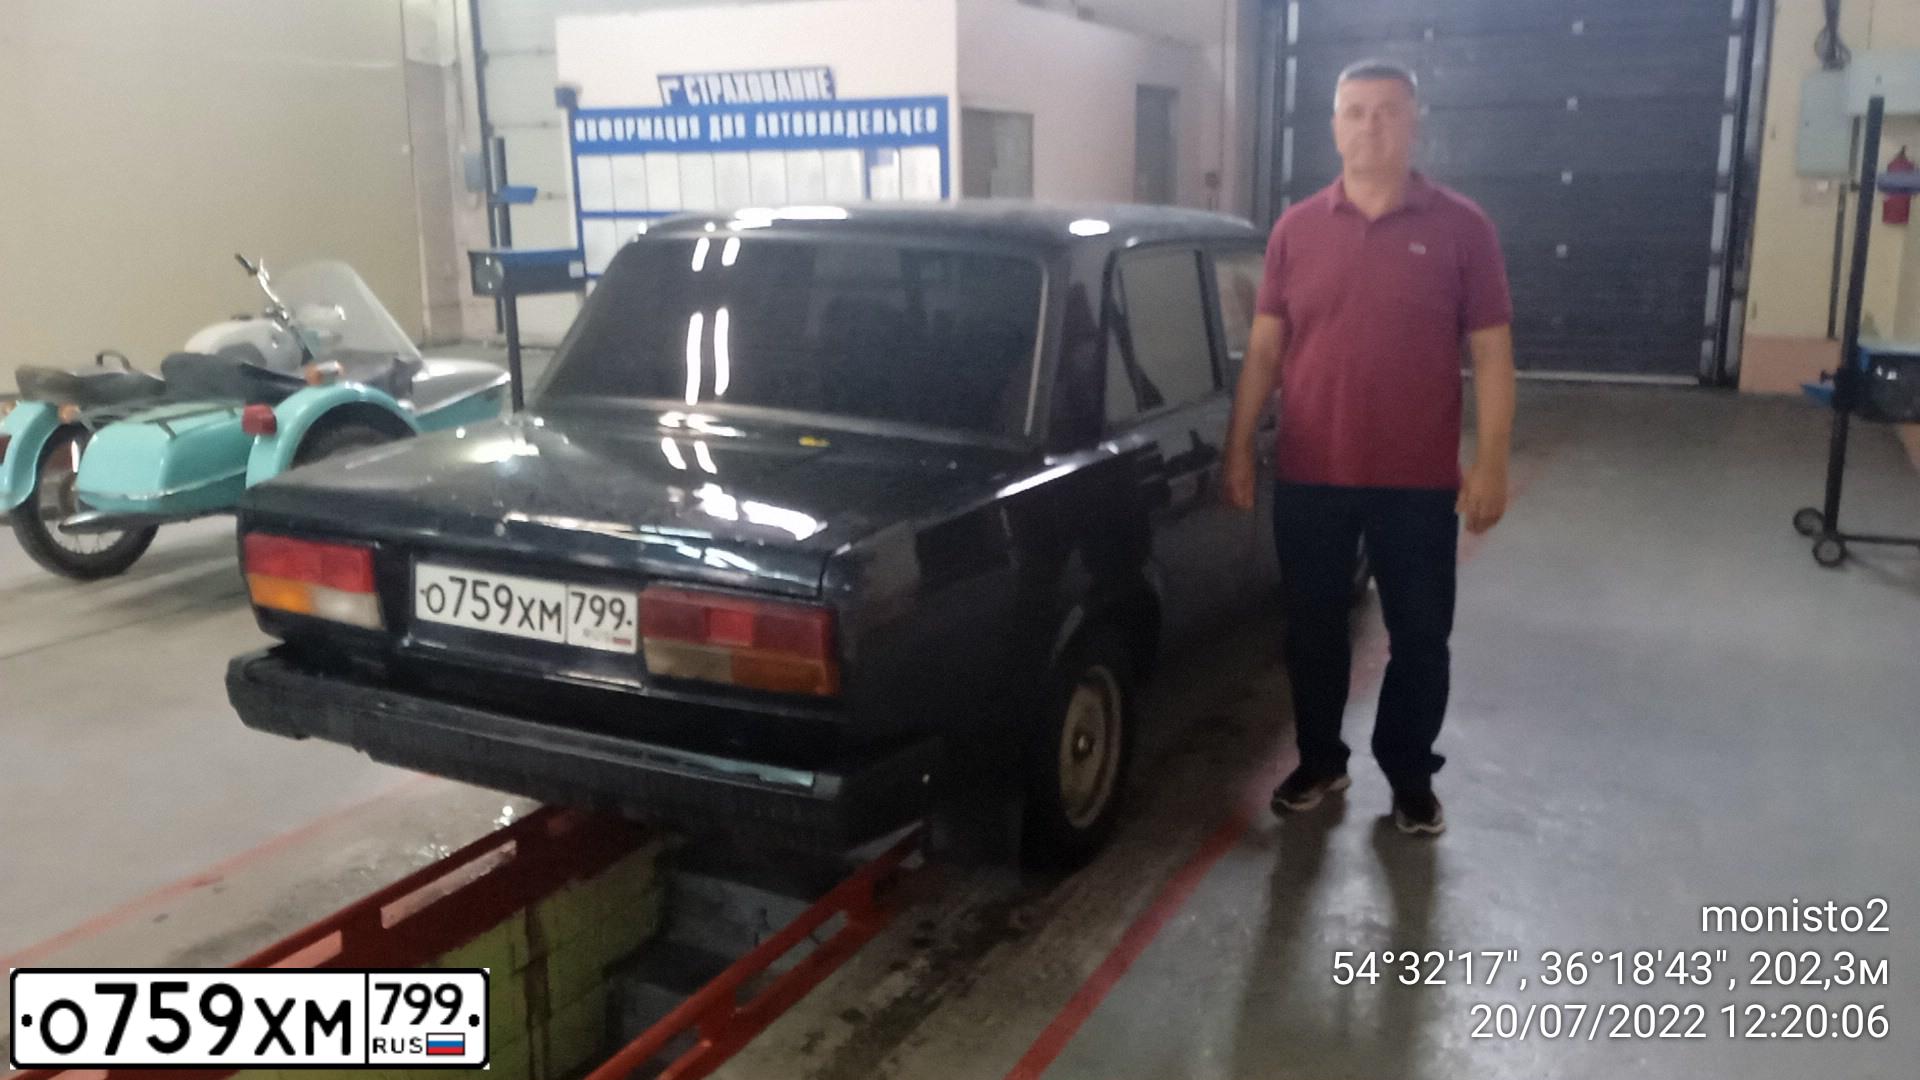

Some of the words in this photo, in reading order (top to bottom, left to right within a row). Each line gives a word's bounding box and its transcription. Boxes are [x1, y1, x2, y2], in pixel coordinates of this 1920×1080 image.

[684, 68, 834, 106] СТРАХОВАНИЕ
[575, 114, 701, 142] ИНФОРМАЦИЯ
[710, 112, 746, 143] ДЛЯ
[756, 106, 938, 140] АВТОВЛАДЕЛЬЦЕВ
[571, 591, 626, 631] 799
